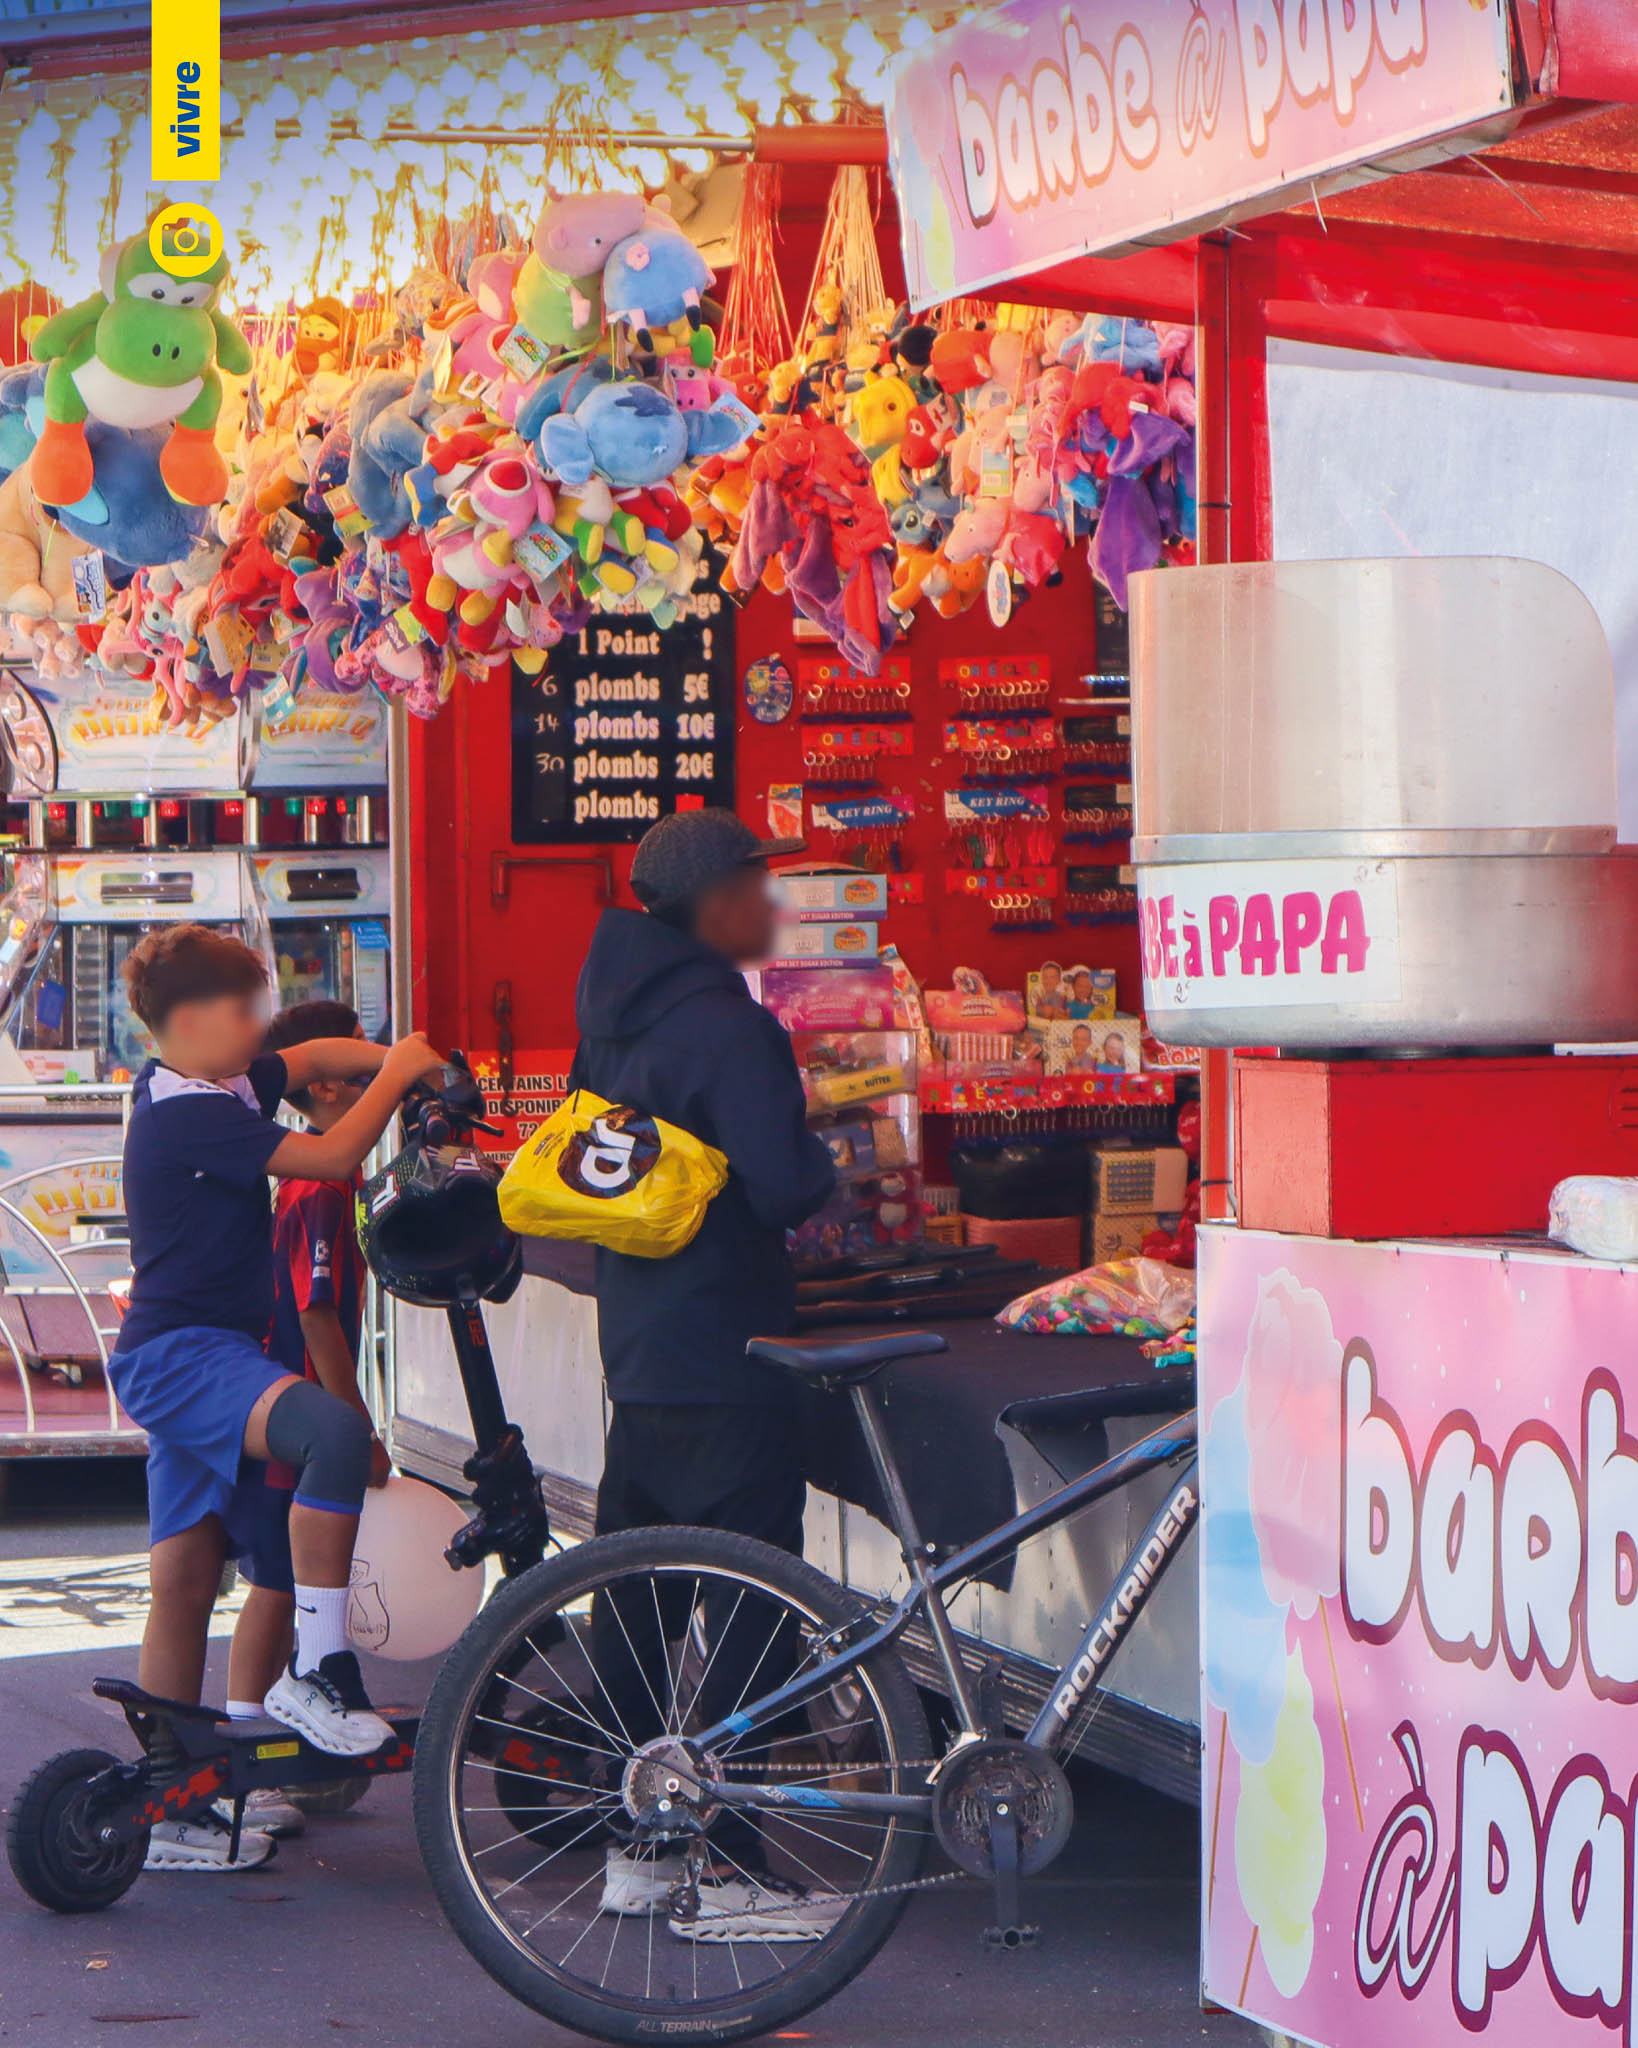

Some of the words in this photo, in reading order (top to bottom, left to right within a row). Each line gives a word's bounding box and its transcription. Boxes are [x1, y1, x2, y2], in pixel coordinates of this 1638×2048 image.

[596, 628, 660, 656] Point
[541, 675, 558, 695] 6
[574, 672, 660, 706] plombs
[683, 673, 710, 702] 5€
[534, 713, 560, 735] 14
[574, 711, 660, 745] plombs
[676, 713, 715, 740] 10€
[574, 750, 659, 784] plombs
[676, 752, 715, 779] 20€
[574, 790, 659, 824] plombs
[837, 807, 861, 818] KEY
[864, 804, 893, 816] RING
[970, 797, 994, 807] KEY
[996, 796, 1026, 806] RING
[1208, 889, 1370, 977] PAPA
[1053, 1486, 1197, 1722] ROCKRIDER
[1452, 1721, 1638, 2048] pa
[636, 2020, 658, 2032] ALL
[660, 2019, 713, 2033] TERRAIN
